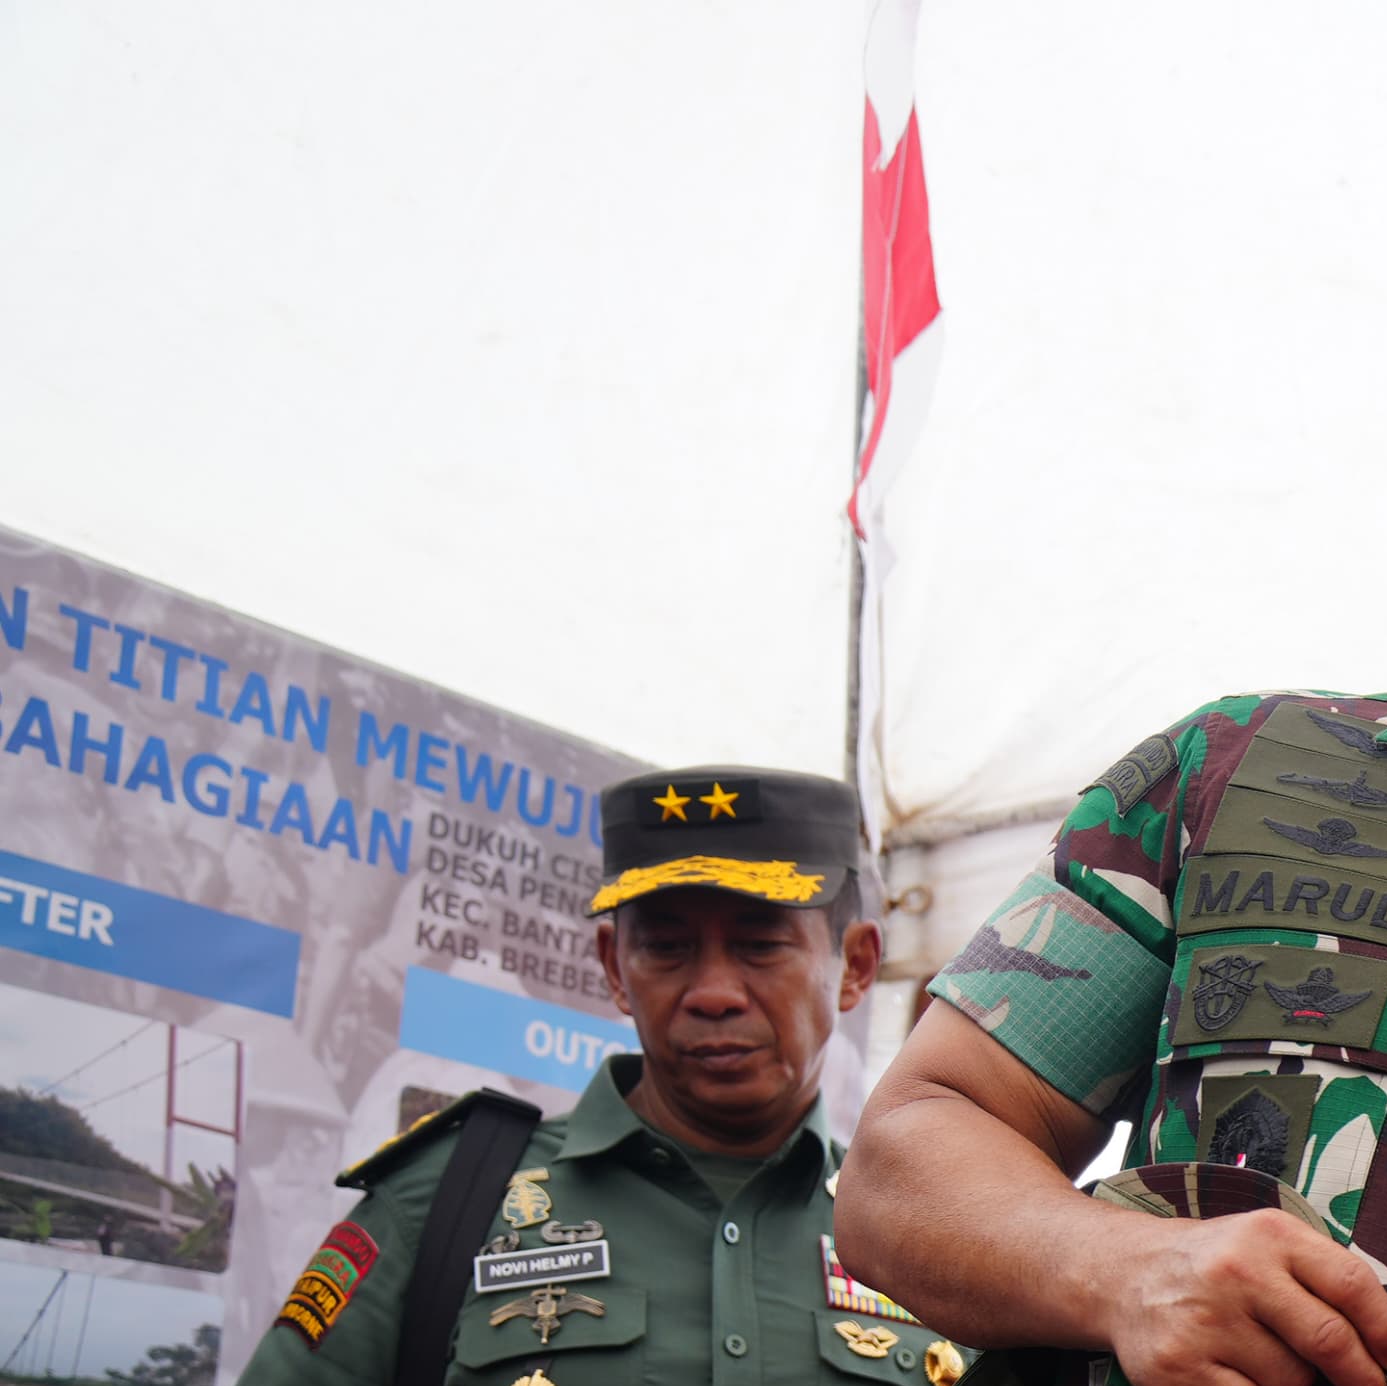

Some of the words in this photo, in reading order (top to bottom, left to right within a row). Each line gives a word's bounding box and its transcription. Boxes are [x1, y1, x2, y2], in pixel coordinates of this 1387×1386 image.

[58, 602, 332, 754] TITIAN
[0, 688, 413, 876] AHAGIAAN
[427, 812, 541, 871] DUKUH
[427, 846, 509, 896] DESA
[420, 883, 490, 930] KEC.
[415, 920, 488, 966] KAB.
[488, 1260, 529, 1278] NOVI
[529, 1253, 580, 1273] HELMY
[581, 1251, 594, 1265] P
